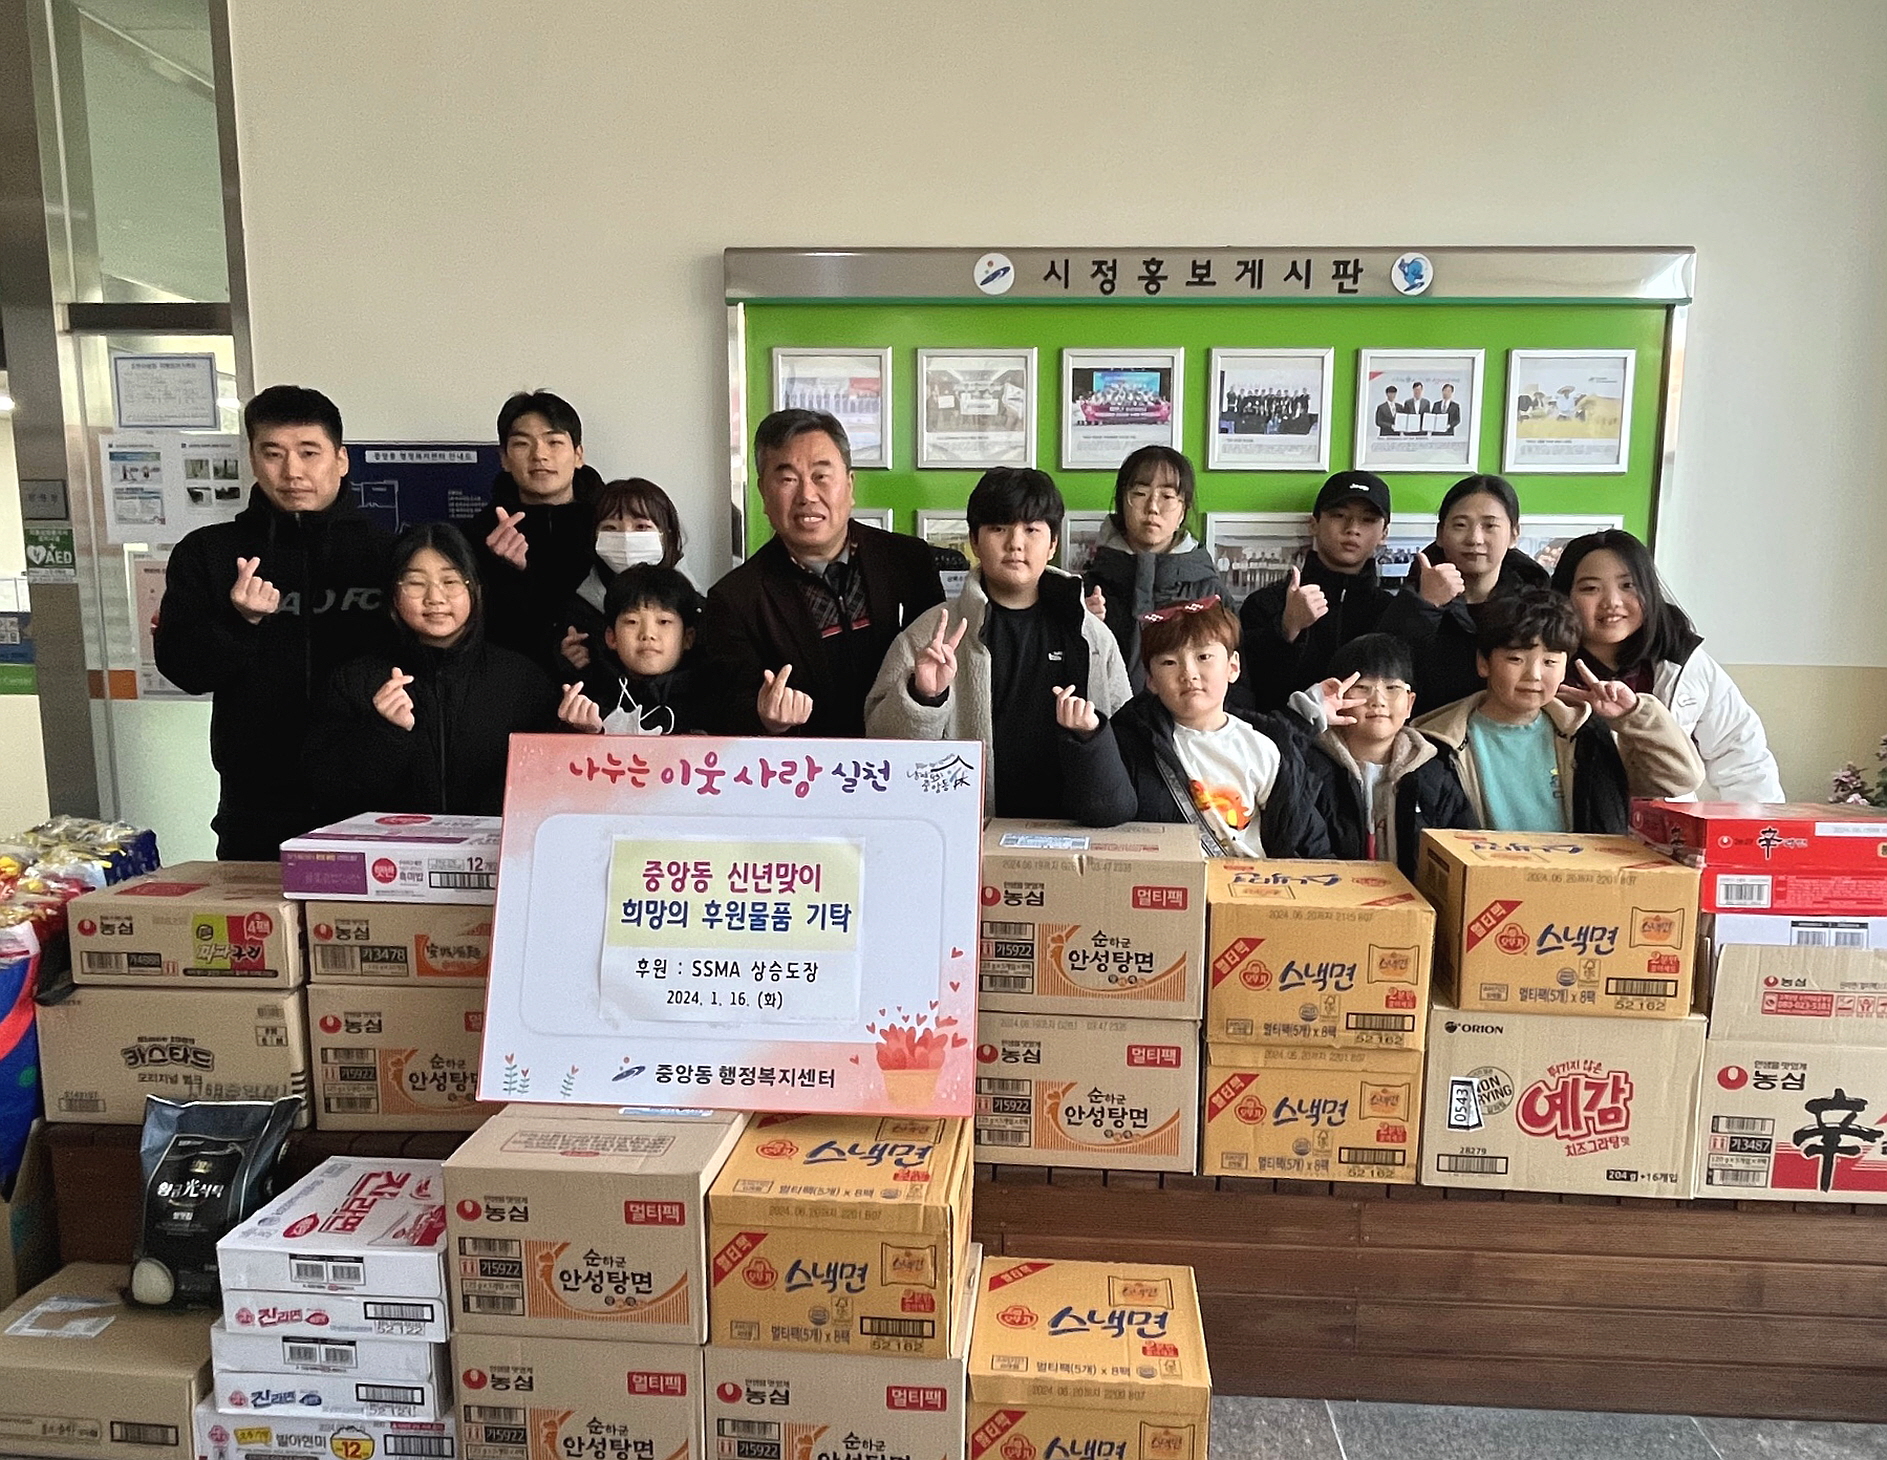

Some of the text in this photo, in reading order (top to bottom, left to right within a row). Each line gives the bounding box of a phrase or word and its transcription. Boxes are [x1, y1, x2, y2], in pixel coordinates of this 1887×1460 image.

[45, 551, 72, 564] AED
[569, 751, 891, 799] 나누는 이웃 사랑 실천
[1758, 826, 1782, 859] 辛
[642, 861, 822, 893] 중앙동 신년맞이
[1004, 890, 1044, 906] 농심
[1137, 890, 1183, 906] 멀티팩
[621, 899, 852, 932] 희망의 후원물품 기탁
[1469, 902, 1507, 937] 멀티팩
[100, 921, 133, 935] 농심
[248, 921, 270, 933] 4팩
[336, 926, 369, 940] 농심
[1642, 921, 1674, 933] 스낵면
[1091, 930, 1131, 946] 순하군
[1501, 935, 1524, 948] 오뚜기
[1536, 923, 1619, 956] 스낵면
[1068, 949, 1153, 973] 안성탕면
[1215, 940, 1251, 973] 멀티팩
[635, 959, 668, 979] 후원
[692, 961, 741, 978] SSMA
[751, 960, 818, 982] 상승도장
[1280, 960, 1357, 991] 스낵면
[1781, 978, 1806, 987] 농심
[666, 990, 783, 1010] 2024. 1. 16. (화)
[1519, 987, 1568, 1003] 멀티팩(5개)
[1579, 990, 1595, 1005] 8팩
[1616, 1001, 1665, 1010] 52162
[345, 1019, 382, 1033] 농심
[1263, 1022, 1310, 1035] 멀티팩(5개)
[1321, 1025, 1336, 1036] 8팩
[1461, 1024, 1504, 1034] ORION
[122, 1046, 214, 1070] 카스타드
[430, 1054, 466, 1069] 순하군
[1002, 1048, 1040, 1064] 농심
[1132, 1047, 1177, 1065] 멀티팩
[655, 1064, 835, 1088] 중앙동 행정복지센터
[1547, 1059, 1603, 1077] 튀기지 않은
[1753, 1071, 1806, 1090] 농심
[1087, 1087, 1126, 1104] 순하군
[1211, 1076, 1245, 1109] 멀티팩
[1478, 1085, 1512, 1106] RYING
[1273, 1097, 1349, 1127] 스낵면
[1455, 1088, 1468, 1122] 0543
[1521, 1075, 1628, 1131] 예감
[1065, 1106, 1148, 1127] 안성탕면
[1792, 1088, 1884, 1193] 辛
[804, 1141, 932, 1168] 스낵면
[1258, 1156, 1303, 1172] 멀티팩(5개)
[1314, 1159, 1329, 1173] 8팩
[1609, 1171, 1627, 1180] 204
[484, 1204, 529, 1223] 농심
[629, 1204, 680, 1222] 멀티팩
[583, 1248, 626, 1267] 순하군
[716, 1236, 753, 1272] 멀티팩
[560, 1270, 652, 1294] 안성탕면
[786, 1260, 868, 1293] 스낵면
[1001, 1265, 1033, 1283] 멀티팩
[259, 1308, 303, 1327] 진라면
[1048, 1306, 1169, 1338] 스낵면
[772, 1326, 822, 1343] 멀티팩(5개)
[834, 1329, 850, 1344] 8팩
[1036, 1361, 1097, 1376] 멀티팩(5개)
[1112, 1365, 1130, 1377] 8팩
[490, 1375, 534, 1391] 농심
[633, 1375, 682, 1393] 멀티팩
[251, 1389, 296, 1407] 진라면
[745, 1387, 789, 1406] 농심
[892, 1389, 942, 1408] 멀티팩
[586, 1417, 629, 1435] 순하군
[975, 1412, 1011, 1446] 멀티팩
[341, 1441, 361, 1459] 12
[563, 1436, 654, 1460] 안성탕면
[842, 1431, 886, 1450] 순하군
[1045, 1437, 1128, 1460] 스낵면
